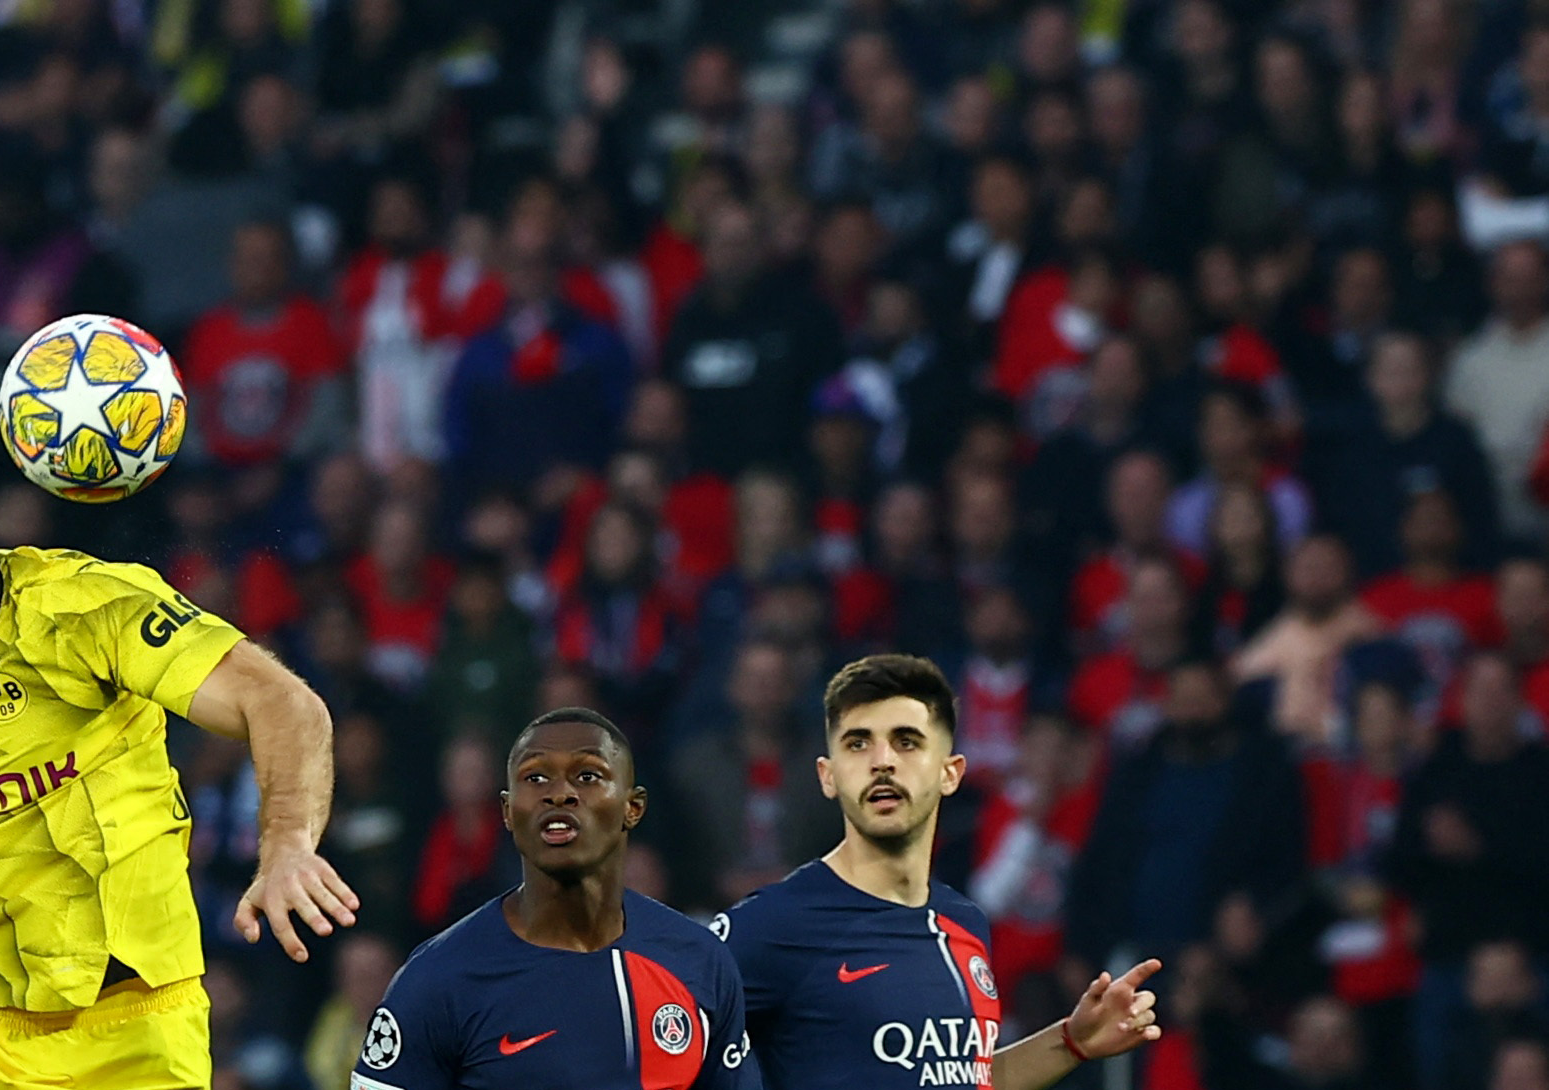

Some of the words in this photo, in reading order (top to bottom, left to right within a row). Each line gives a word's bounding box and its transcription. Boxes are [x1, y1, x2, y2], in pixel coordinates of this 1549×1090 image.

[141, 593, 201, 648] GLS
[0, 702, 15, 716] 09
[873, 1017, 999, 1070] QATAR
